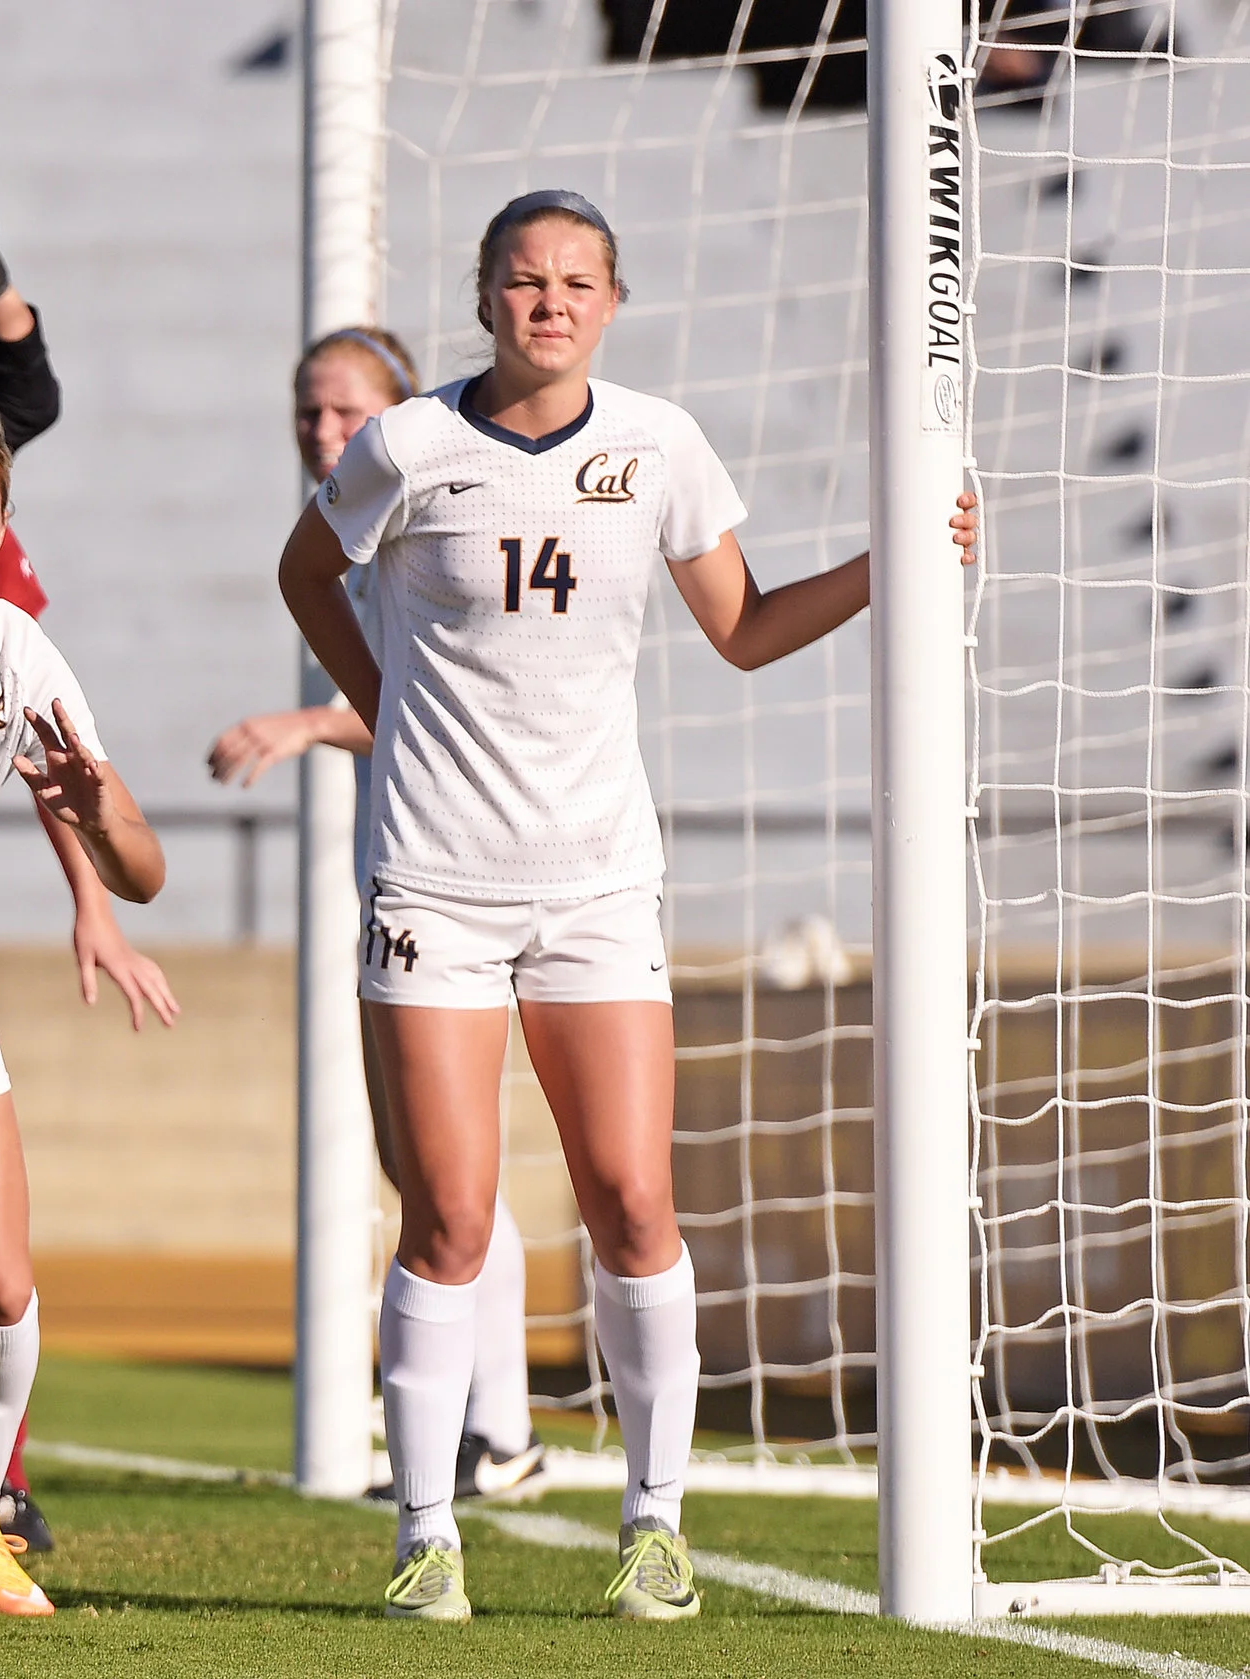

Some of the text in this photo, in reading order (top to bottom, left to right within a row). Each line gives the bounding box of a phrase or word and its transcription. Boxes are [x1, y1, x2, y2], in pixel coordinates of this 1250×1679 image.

[574, 453, 639, 503] Cal
[498, 536, 577, 614] 14
[380, 926, 419, 972] 14
